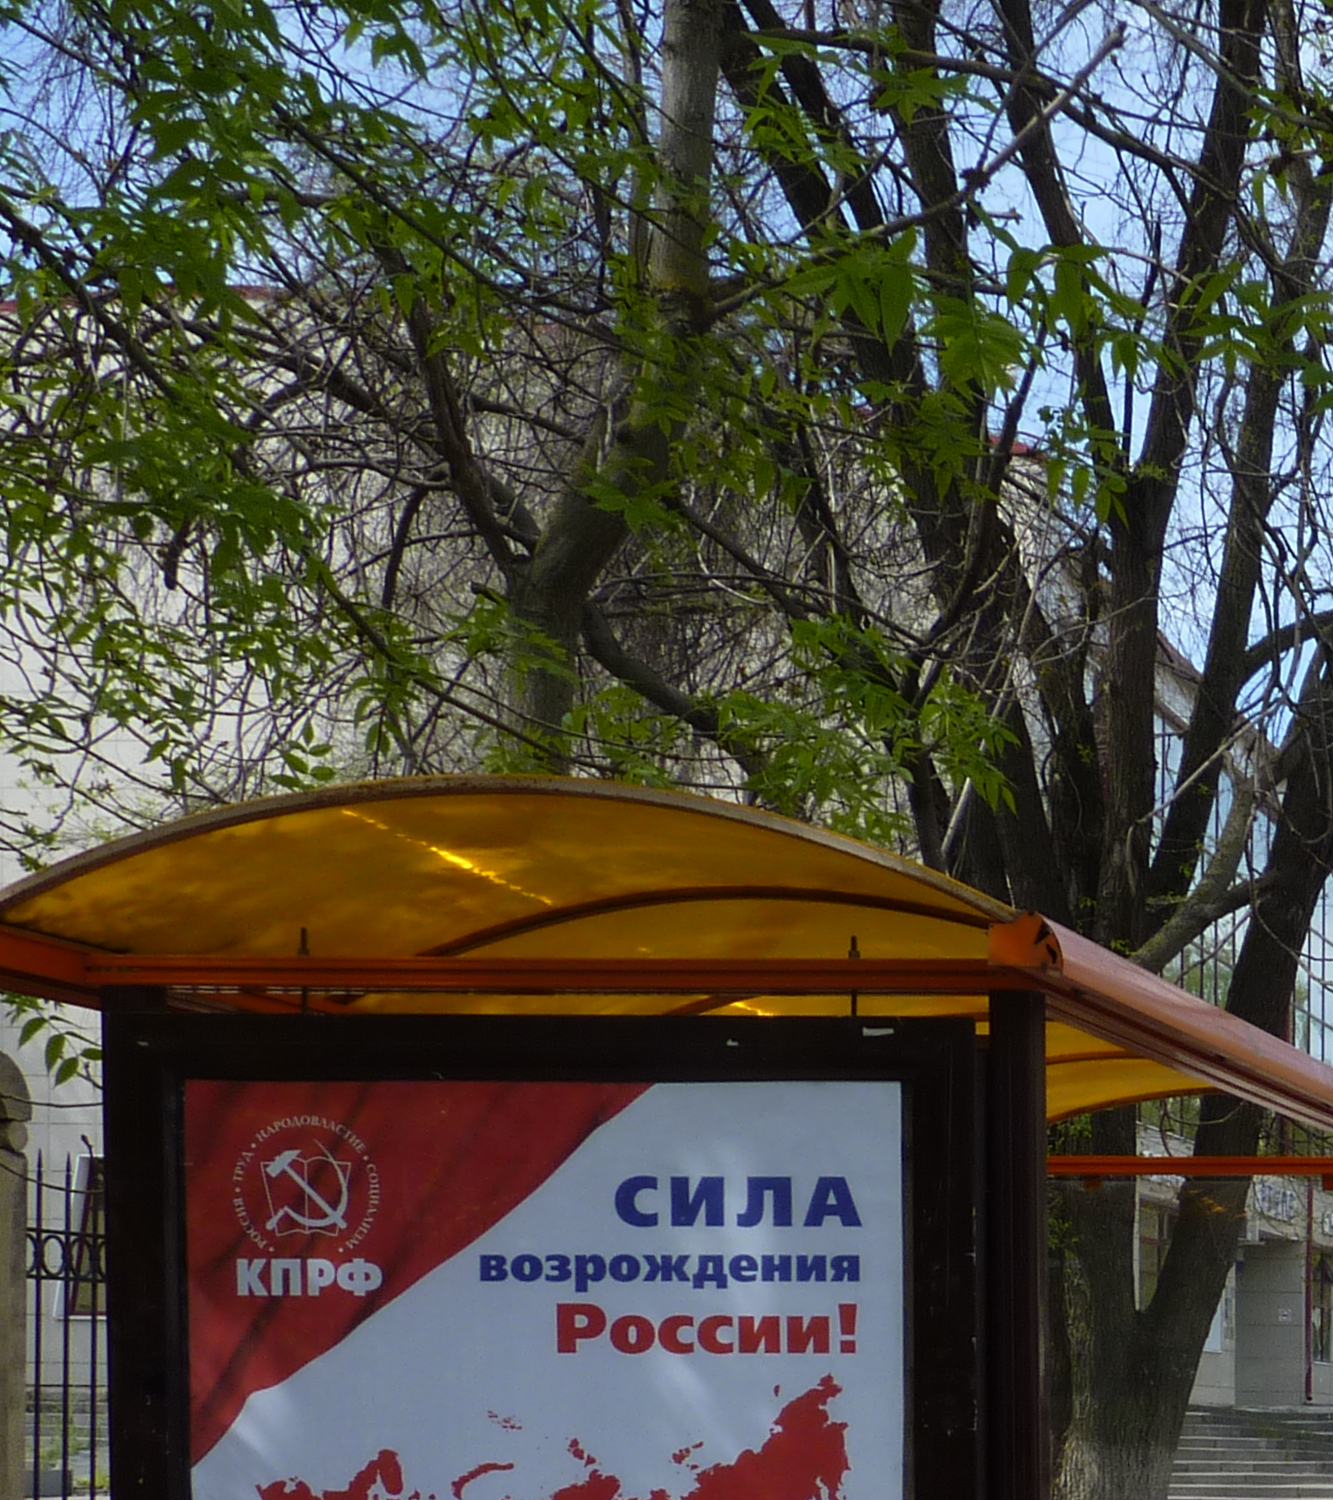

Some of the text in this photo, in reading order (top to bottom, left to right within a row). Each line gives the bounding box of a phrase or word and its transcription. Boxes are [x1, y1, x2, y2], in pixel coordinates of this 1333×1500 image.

[233, 1115, 380, 1249] РОССИЯ ТРУД НАРОДОВЛАСТИЕ СОЦИАЛИЗМ
[614, 1175, 863, 1228] СИЛА
[236, 1258, 383, 1297] КПРФ
[480, 1253, 861, 1293] возрождения
[557, 1303, 858, 1355] России!
